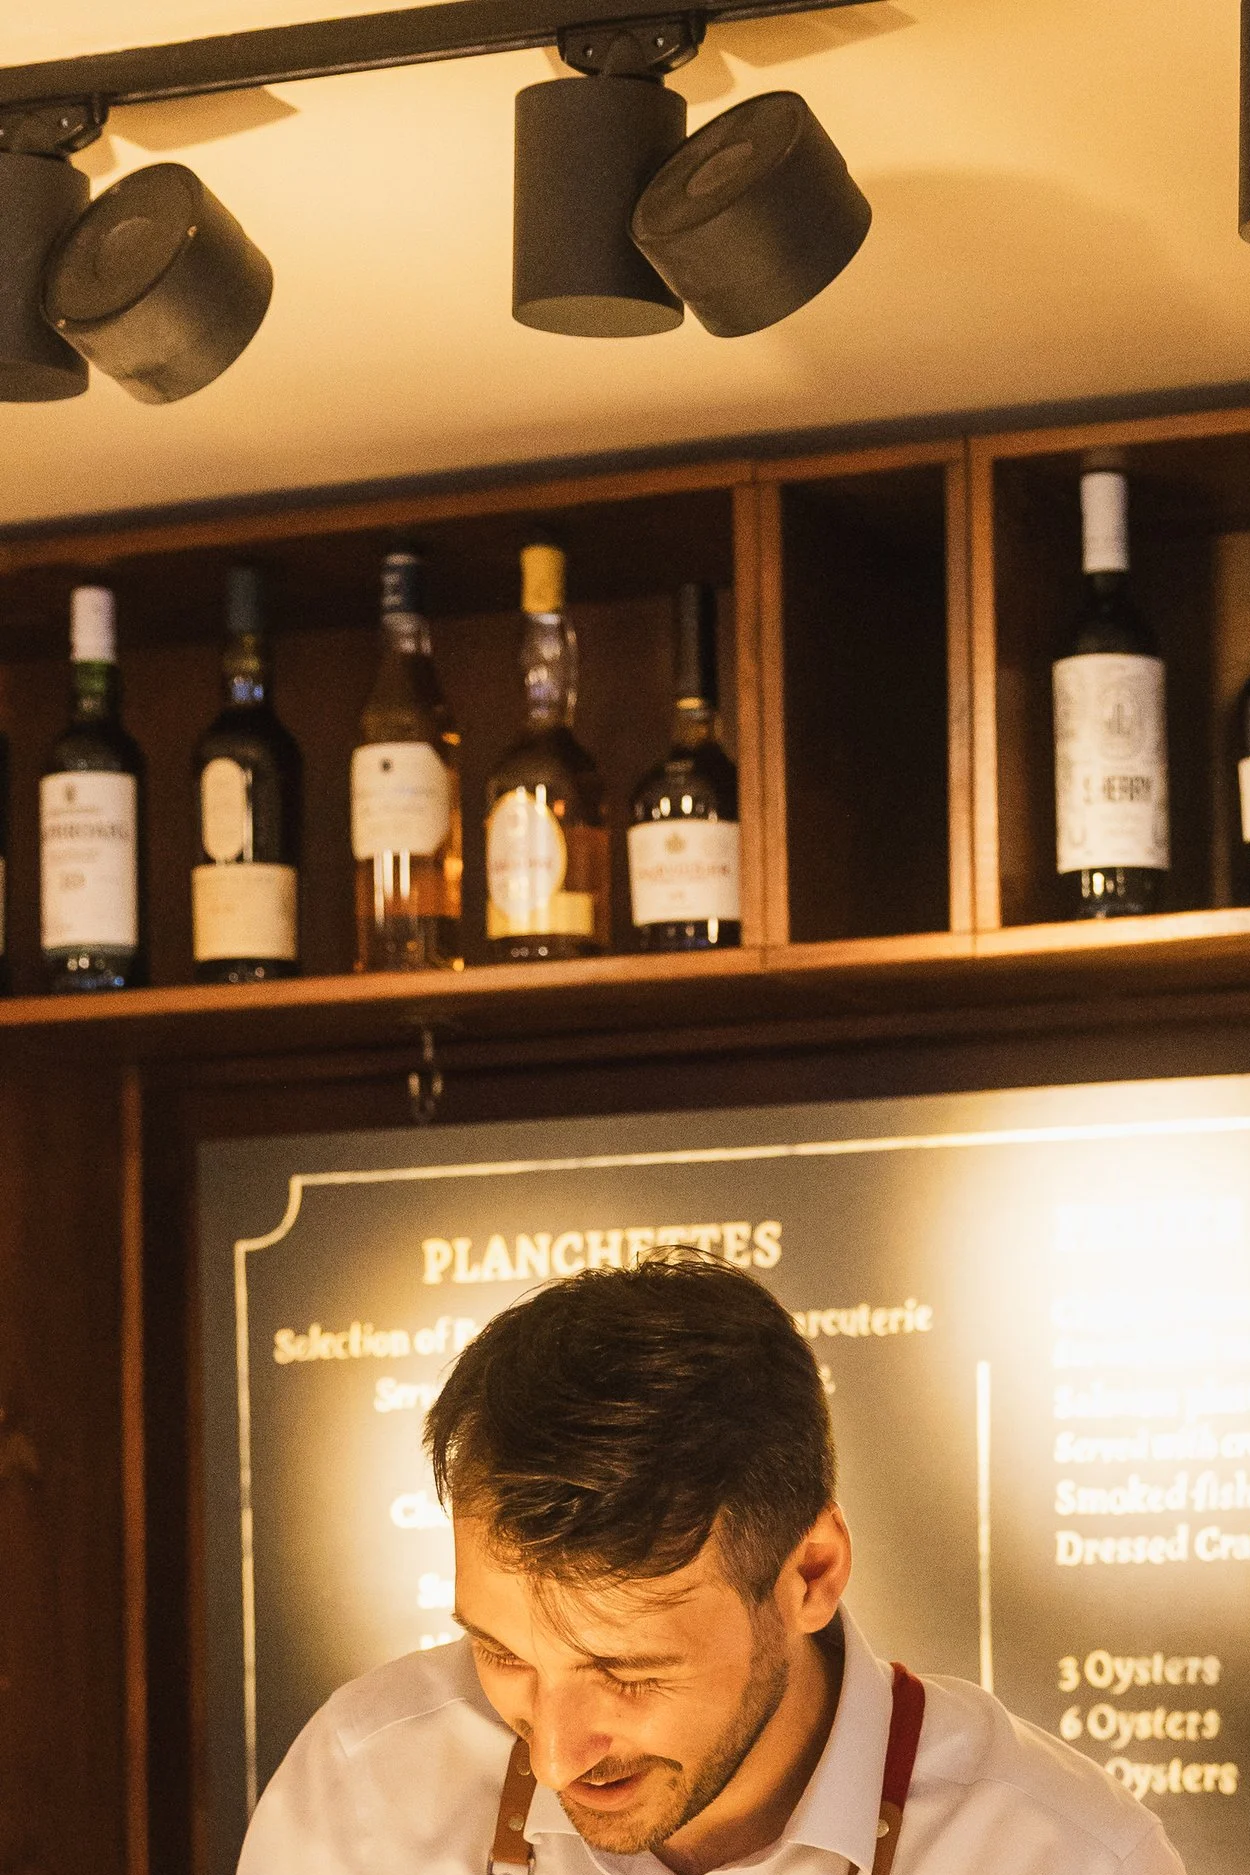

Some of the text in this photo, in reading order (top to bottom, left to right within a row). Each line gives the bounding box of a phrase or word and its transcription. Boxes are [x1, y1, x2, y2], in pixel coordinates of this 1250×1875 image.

[422, 1220, 783, 1285] PLANCHETTES
[273, 1321, 411, 1365] Selection
[414, 1315, 452, 1356] of
[1054, 1473, 1188, 1516] Smoked
[1055, 1522, 1190, 1567] Dressed
[1058, 1649, 1222, 1695] 3 Oysters
[1059, 1702, 1222, 1750] 6 Oysters
[1104, 1756, 1240, 1801] Oysters
